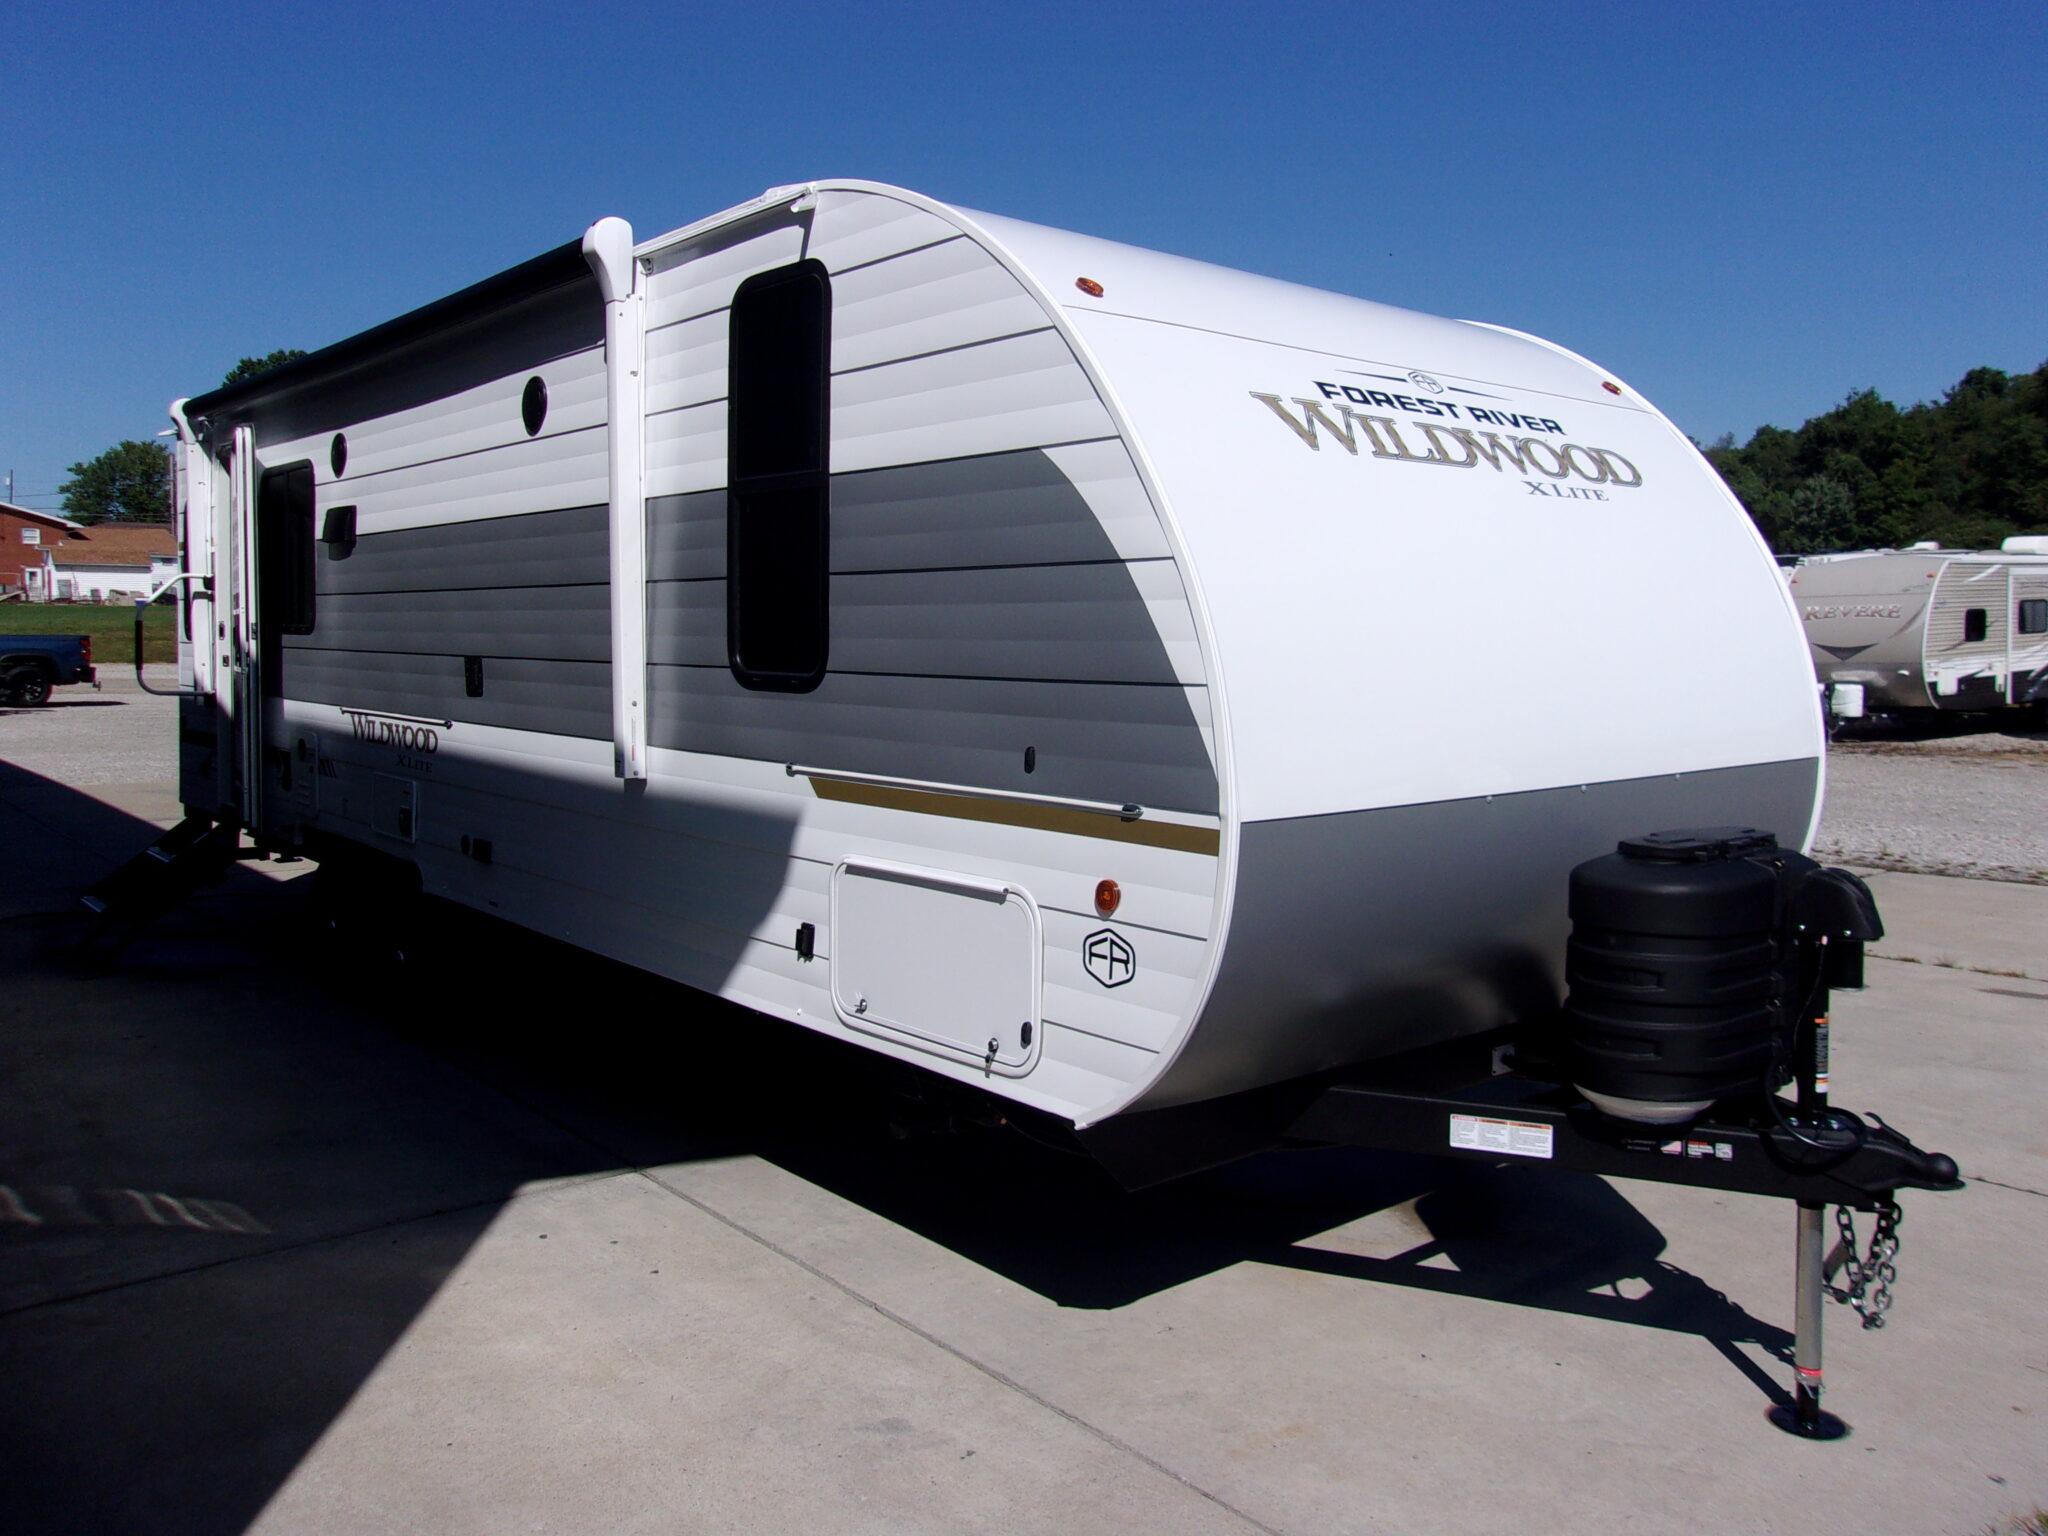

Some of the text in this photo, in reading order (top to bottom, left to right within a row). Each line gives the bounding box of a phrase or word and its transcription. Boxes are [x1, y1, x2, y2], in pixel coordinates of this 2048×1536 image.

[1313, 381, 1567, 436] FOREST RIVER
[1248, 391, 1643, 488] WILDWOOD
[1804, 605, 1904, 621] REVERE
[350, 713, 438, 754] WILDWOOD
